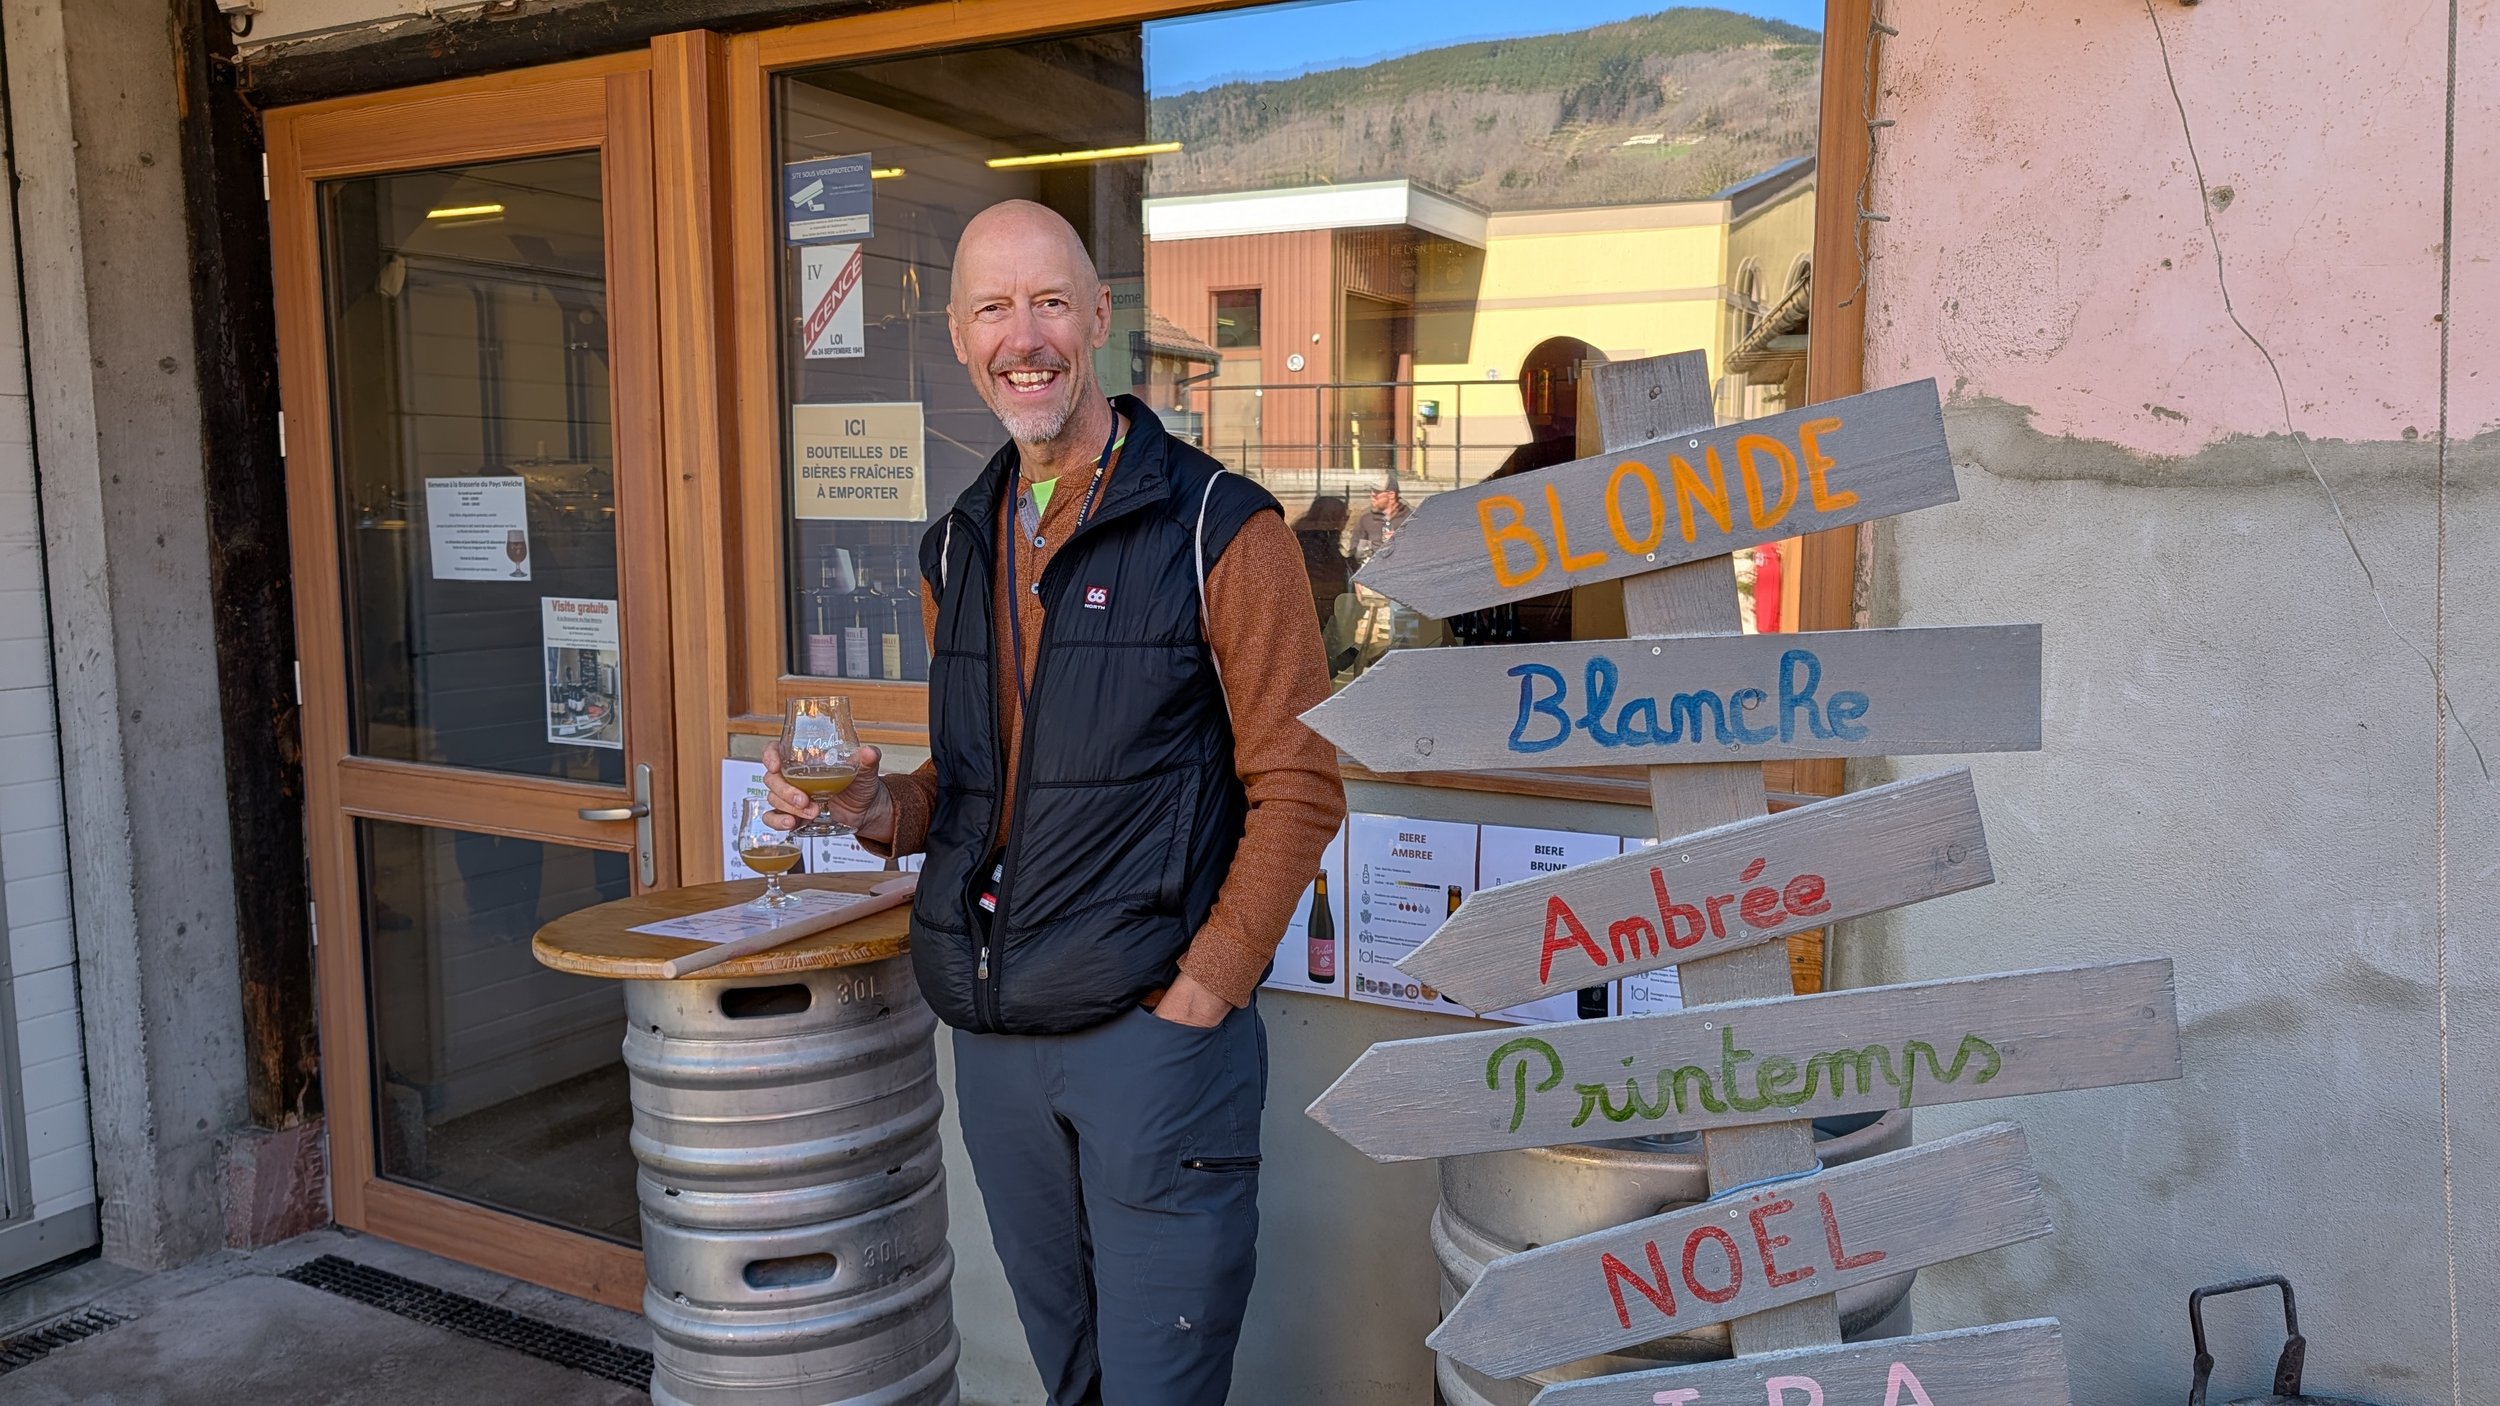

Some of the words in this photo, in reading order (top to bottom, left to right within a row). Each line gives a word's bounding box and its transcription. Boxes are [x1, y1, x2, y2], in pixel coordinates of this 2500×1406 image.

[791, 172, 802, 180] SITE
[802, 170, 816, 178] SOUS
[807, 264, 823, 281] IV
[803, 253, 861, 352] LICENCE
[830, 333, 843, 345] LOI
[845, 419, 866, 436] ICI
[806, 446, 883, 459] BOUTEILLES
[890, 446, 908, 459] DE
[802, 463, 846, 479] BIÈRES
[850, 463, 914, 479] FRAÎCHES
[817, 483, 826, 499] À
[829, 486, 899, 499] EMPORTER
[1476, 417, 1859, 588] BLONDE
[552, 600, 576, 613] Visite
[577, 602, 609, 616] gratuite
[1507, 649, 1870, 753] Blanche
[746, 787, 768, 797] PRINT
[1398, 832, 1427, 844] BIERE
[1391, 847, 1433, 861] AMBREE
[1534, 844, 1565, 857] BIERE
[1539, 856, 1832, 985] Ambrée
[837, 975, 882, 1005] 30L
[1485, 1024, 2002, 1134] Printemps
[863, 1236, 906, 1268] 30L
[1600, 1190, 1887, 1330] NOËL
